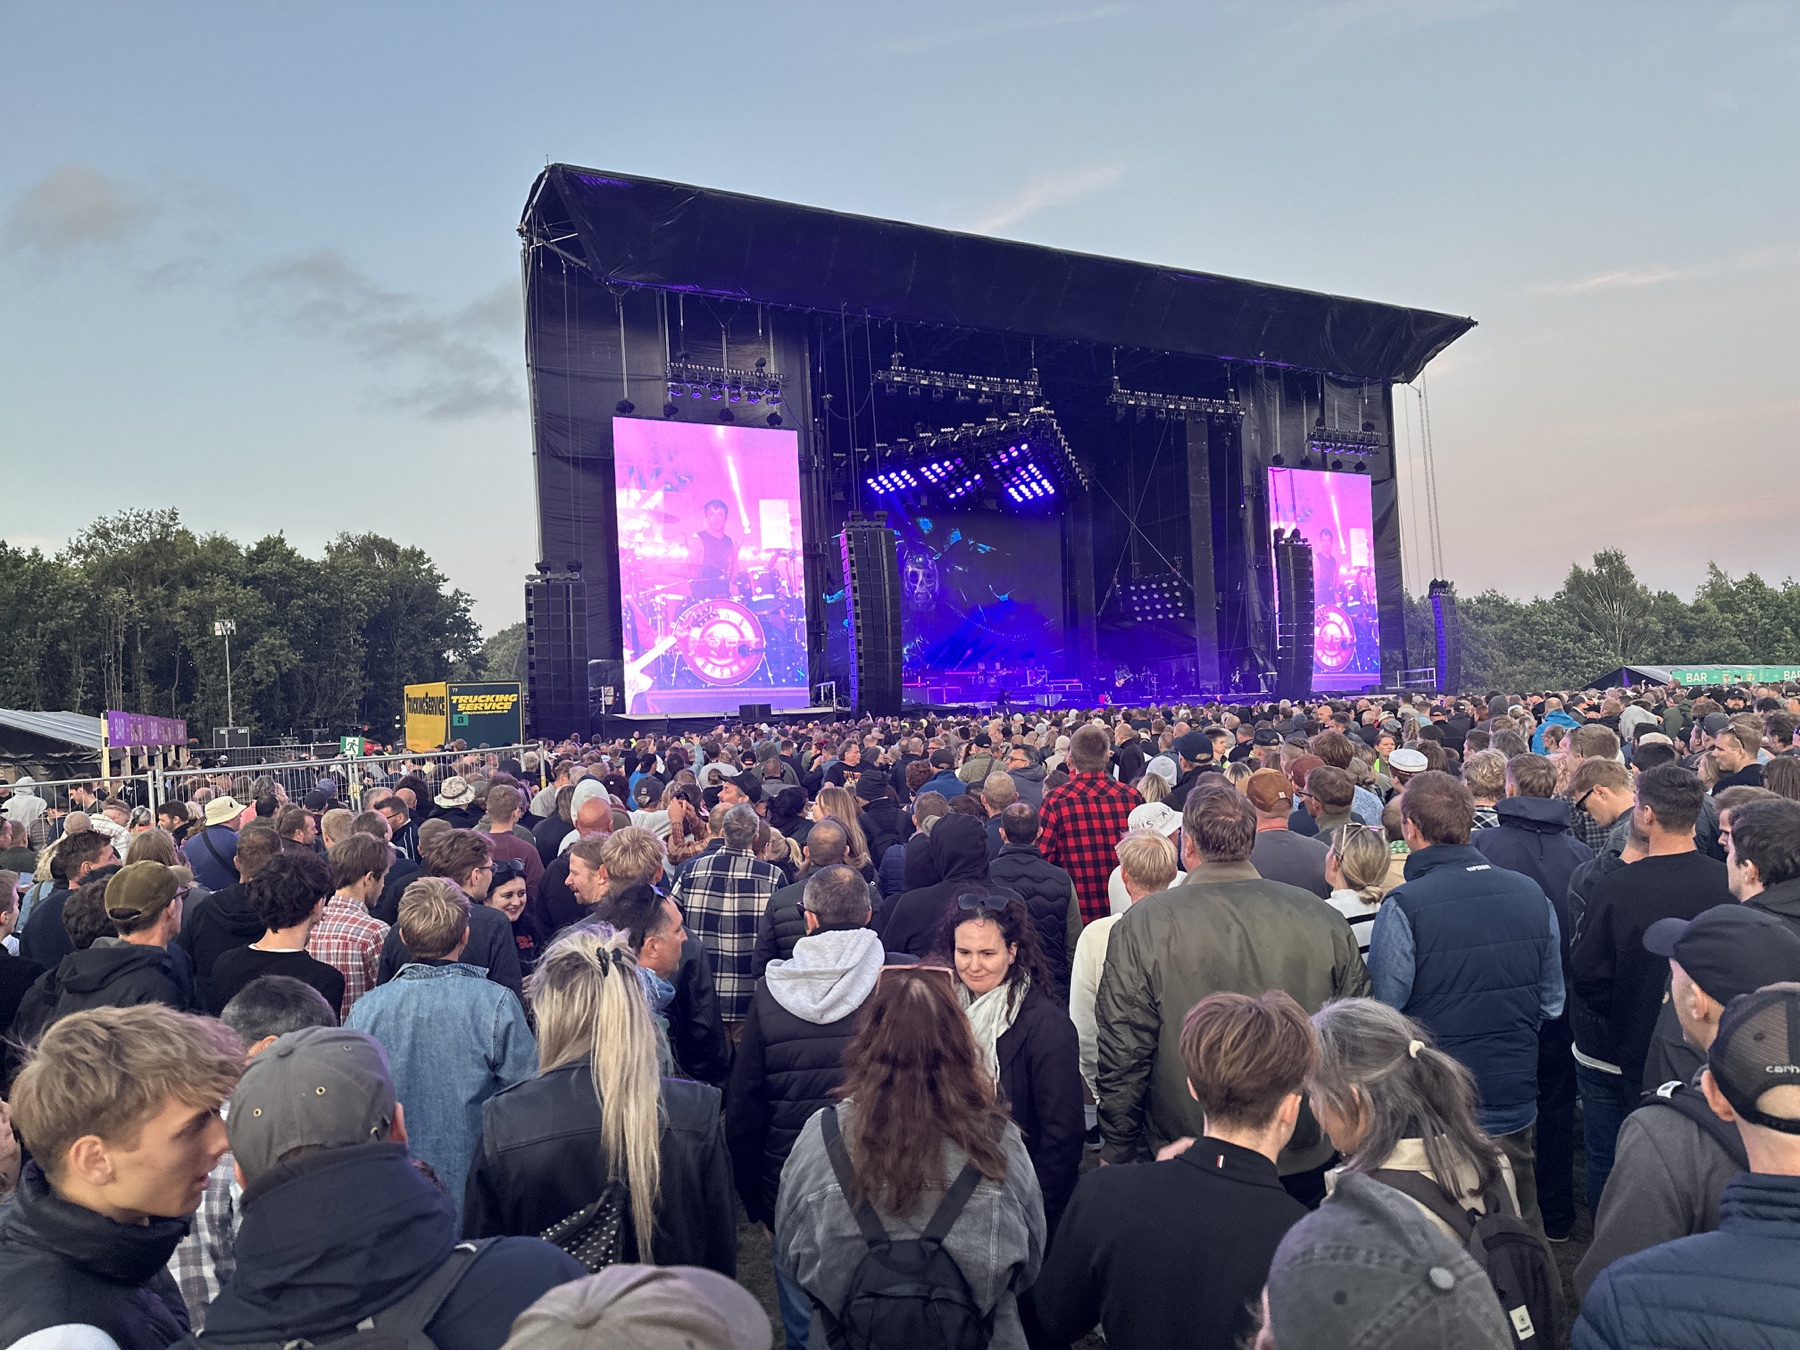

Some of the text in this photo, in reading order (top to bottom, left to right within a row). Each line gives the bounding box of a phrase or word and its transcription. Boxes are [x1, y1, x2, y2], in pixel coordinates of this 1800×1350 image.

[1686, 673, 1708, 682] BAR
[451, 694, 518, 703] TRUCKING
[457, 703, 513, 711] SERVICE
[115, 718, 125, 740] BAR
[150, 721, 158, 740] BAR
[1765, 1064, 1800, 1074] carh
